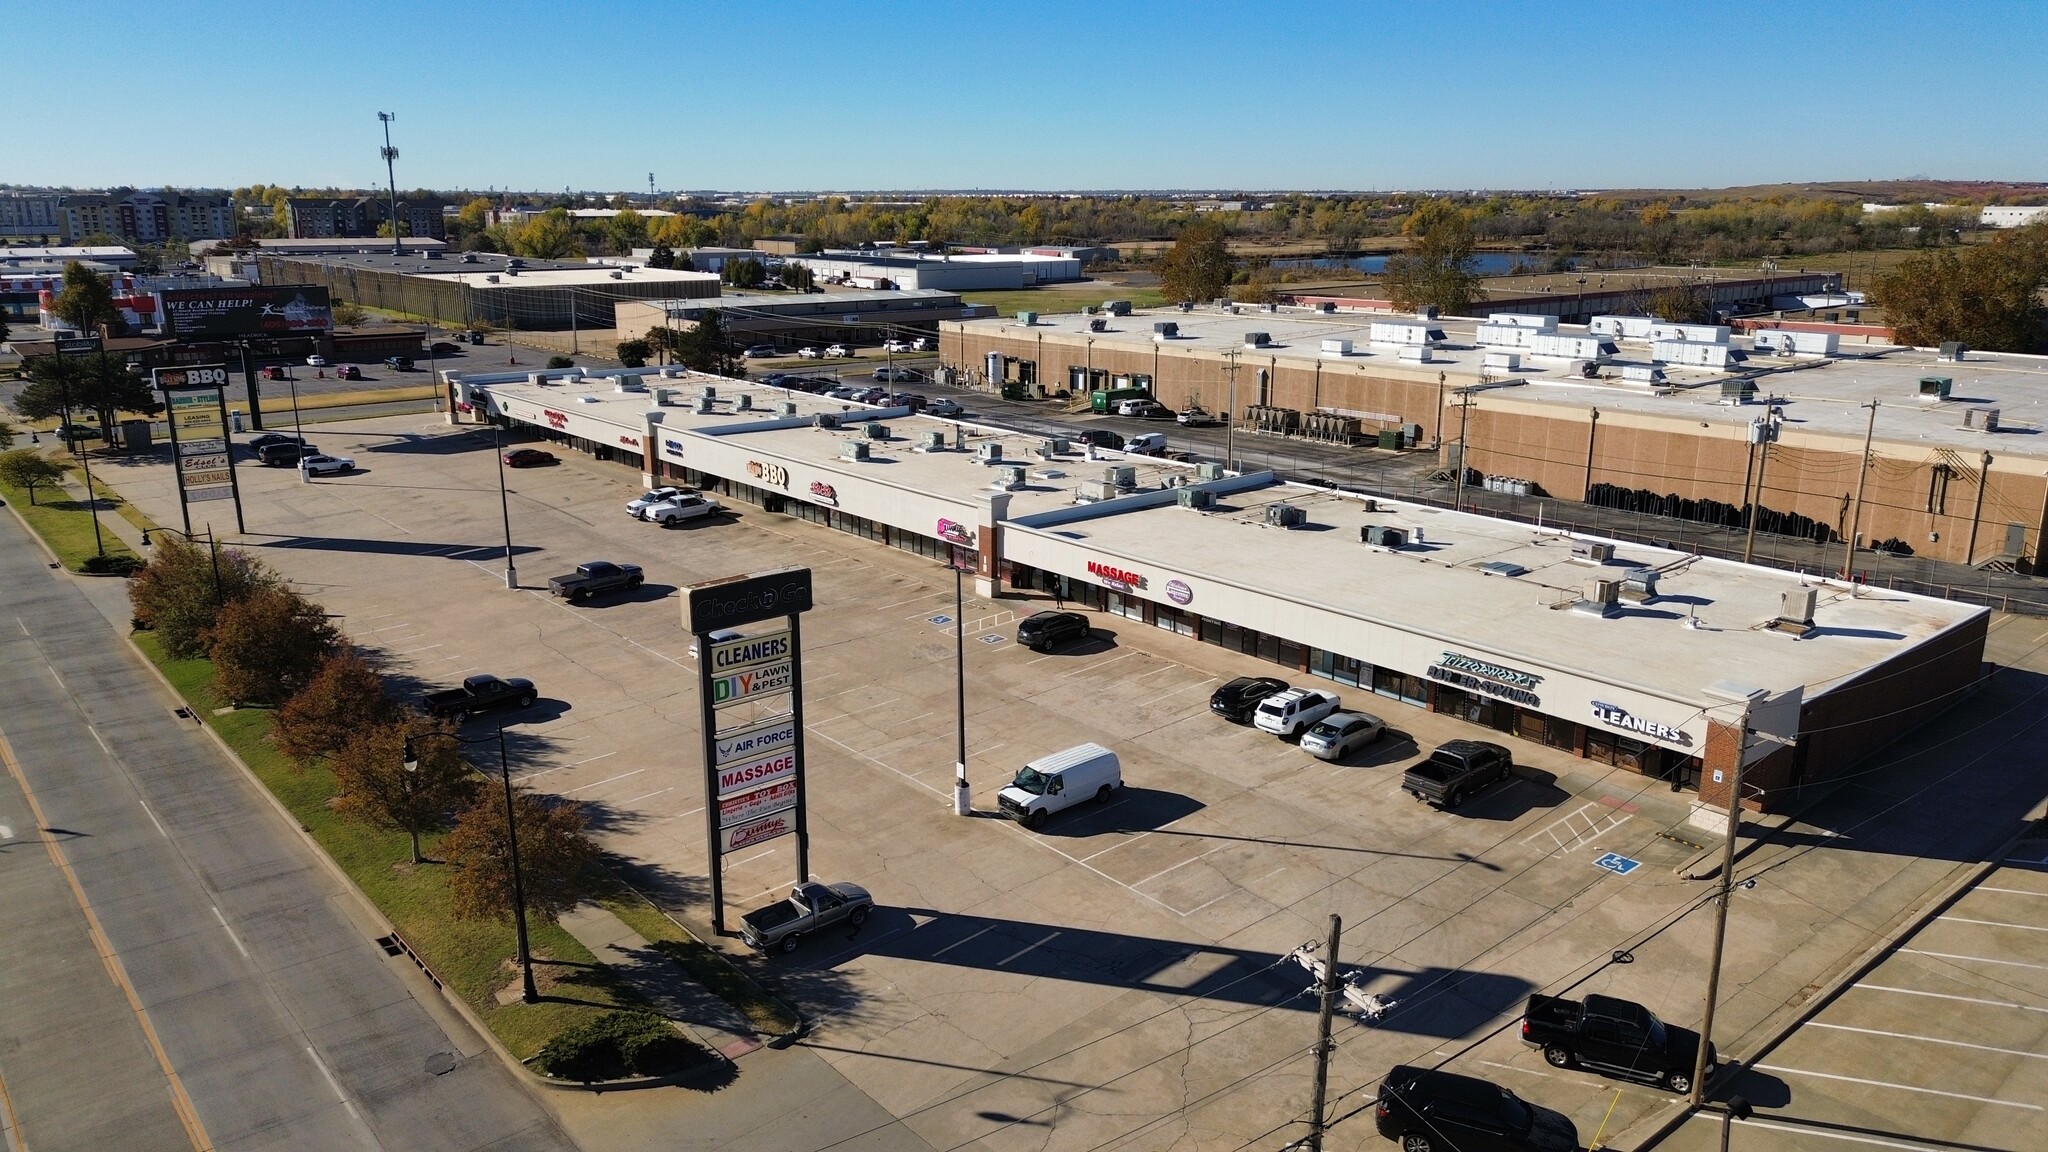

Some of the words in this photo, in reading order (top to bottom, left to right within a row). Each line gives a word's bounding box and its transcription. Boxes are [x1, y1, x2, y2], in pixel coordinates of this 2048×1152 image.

[166, 301, 186, 310] WE
[188, 300, 215, 309] CAN
[217, 299, 254, 308] HELP!
[186, 368, 226, 385] BBQ
[184, 456, 226, 468] Edsel's
[185, 474, 211, 484] HOLLY'S
[211, 472, 230, 481] NAILS
[761, 462, 786, 488] BBQ
[1088, 561, 1140, 586] MASSAGE
[695, 590, 760, 620] Check
[780, 582, 808, 603] Go
[716, 637, 788, 667] CLEANERS
[714, 673, 753, 702] DIY
[755, 664, 790, 680] LAWN
[1592, 707, 1681, 741] CLEANERS
[735, 739, 754, 753] AIR
[756, 728, 793, 747] FORCE
[721, 756, 793, 788] MASSAGE
[754, 788, 773, 800] TOY
[776, 781, 795, 792] BOX
